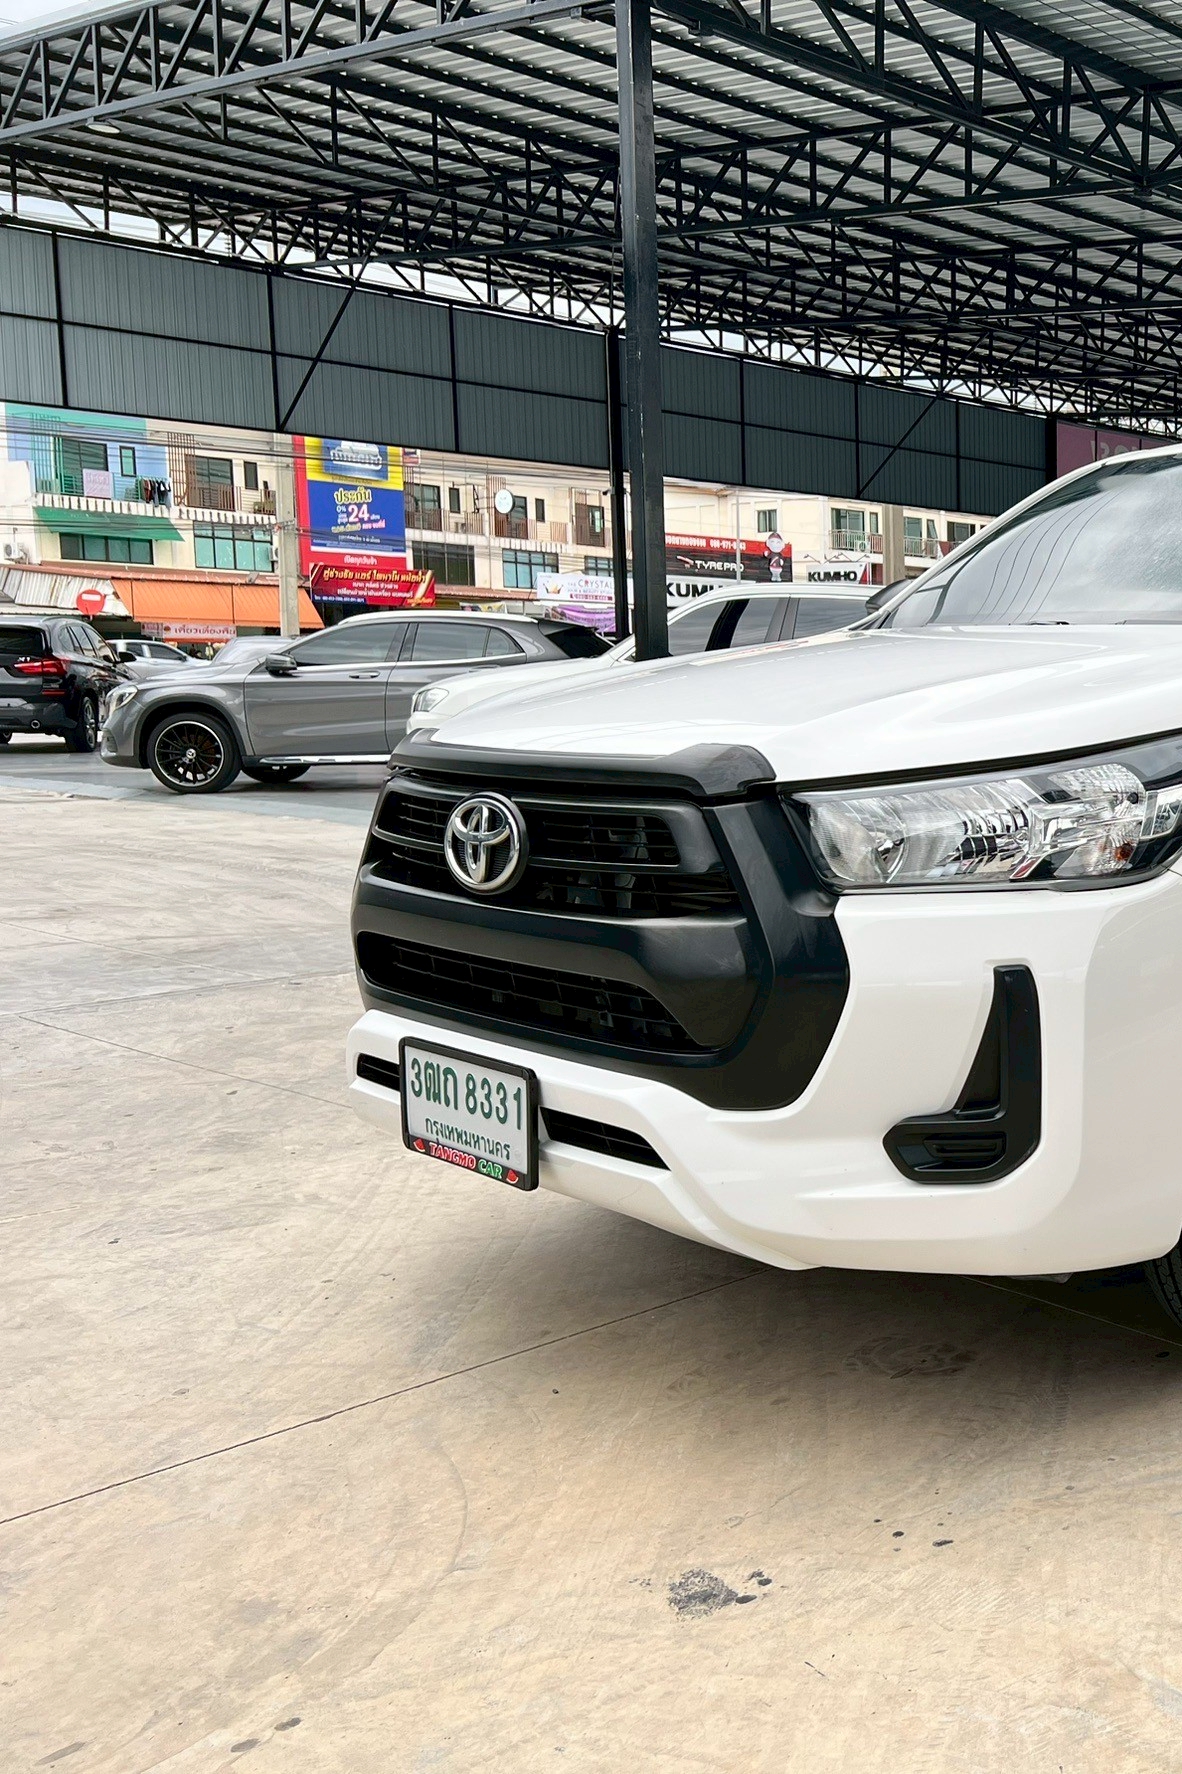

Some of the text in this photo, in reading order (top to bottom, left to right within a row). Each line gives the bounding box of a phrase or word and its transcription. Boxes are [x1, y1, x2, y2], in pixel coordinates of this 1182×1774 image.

[348, 503, 370, 523] 24
[578, 579, 613, 590] CRYSTAL
[808, 570, 857, 582] KUMHO
[666, 582, 723, 598] KUM
[464, 1073, 522, 1131] 8331
[425, 1117, 511, 1161] กรุงเทพมหานคร
[429, 1141, 502, 1180] TANGMO CAR
